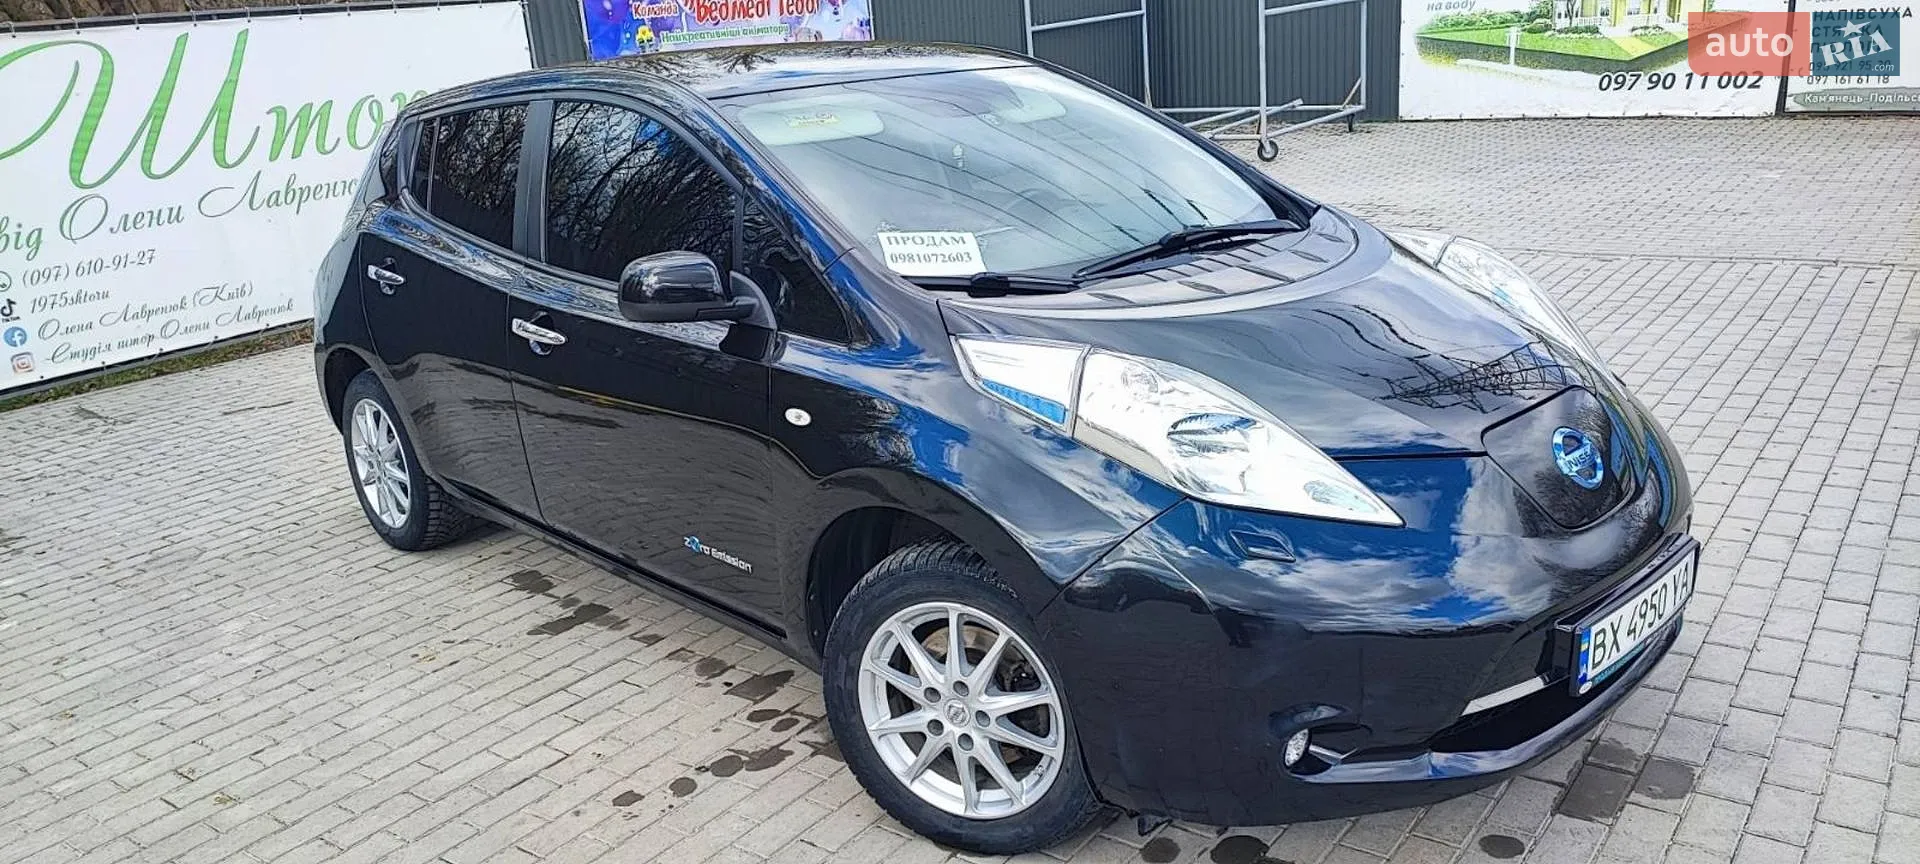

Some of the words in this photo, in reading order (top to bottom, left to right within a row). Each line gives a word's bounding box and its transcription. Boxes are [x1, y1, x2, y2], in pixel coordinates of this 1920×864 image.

[633, 4, 678, 17] Команда
[1599, 73, 1642, 91] 097
[1647, 73, 1676, 90] 90
[1716, 71, 1763, 89] 002
[1806, 75, 1828, 85] 097
[59, 194, 185, 244] Олени
[886, 235, 967, 248] ПРОДАМ
[22, 263, 70, 288] (097)
[75, 248, 156, 277] 610-91-27
[889, 251, 973, 264] 0981072603
[38, 318, 94, 341] Олена
[99, 295, 187, 327] Лавренюк
[192, 280, 253, 307] (Київ)
[116, 333, 155, 350] штор
[160, 319, 210, 339] Олени
[215, 297, 293, 327] Лавренюк
[1591, 614, 1624, 670] BX
[1626, 582, 1669, 642] 4950
[1672, 561, 1689, 607] YA
